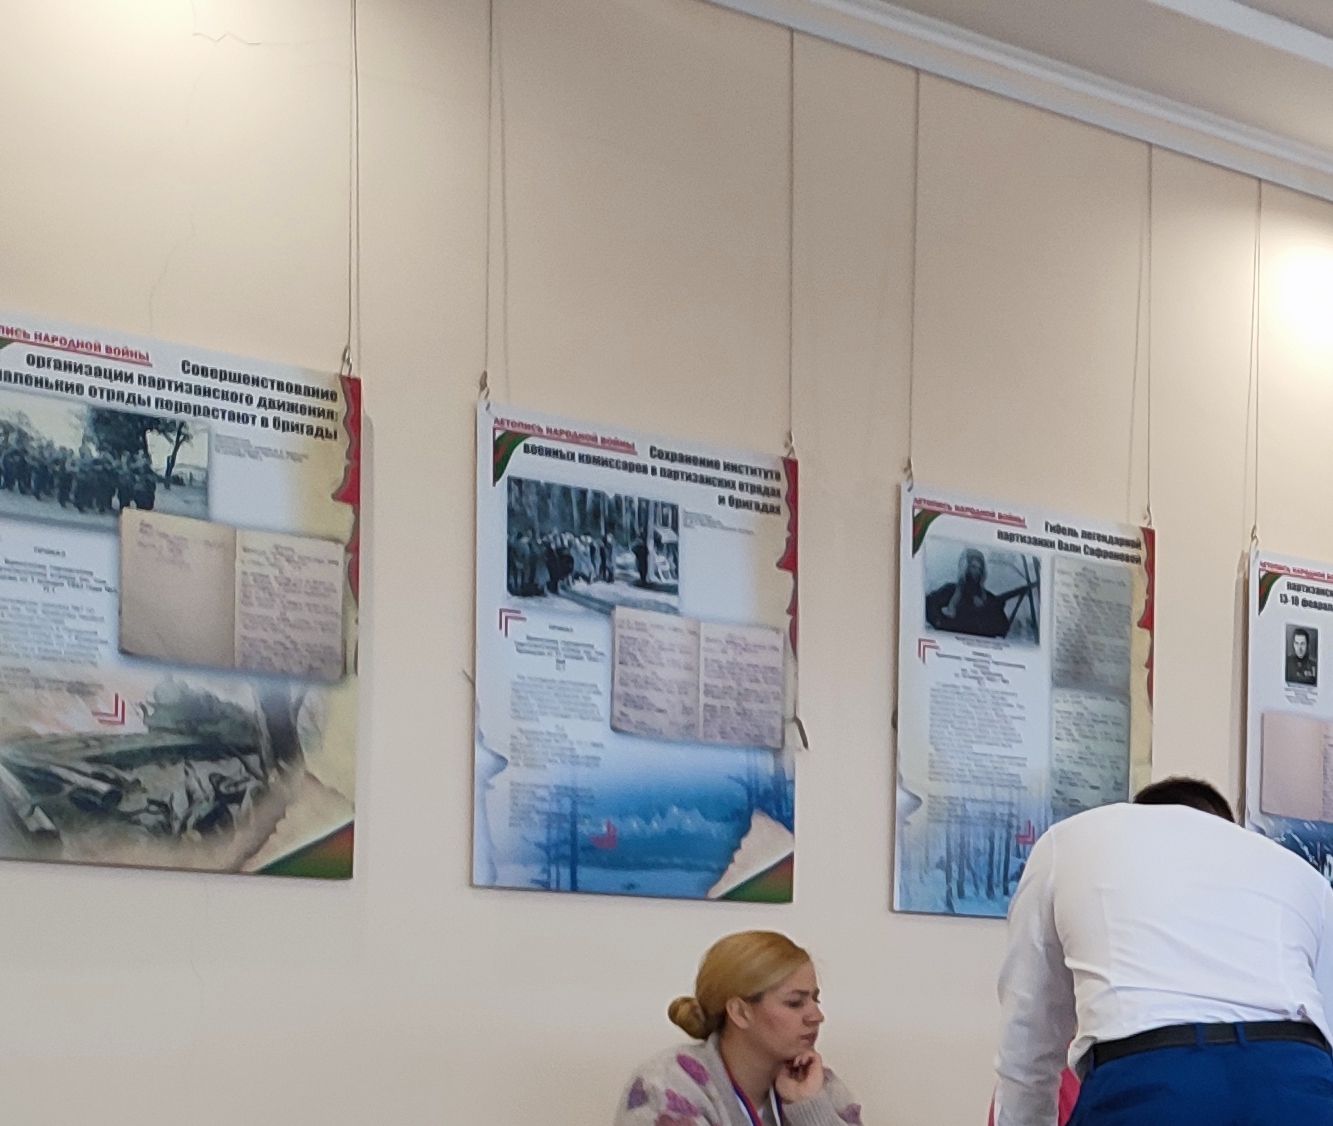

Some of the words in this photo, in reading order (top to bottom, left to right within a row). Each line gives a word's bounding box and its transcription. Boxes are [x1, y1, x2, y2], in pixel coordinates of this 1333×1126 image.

[34, 331, 101, 352] НАРОДНОЙ
[105, 345, 150, 361] ВОЙНЫ
[26, 353, 134, 385] организации
[137, 373, 254, 406] партизанского
[181, 359, 338, 403] Совершенствование
[0, 368, 84, 396] аленькие
[88, 385, 151, 408] отряды
[154, 396, 257, 426] перерастают
[260, 416, 269, 428] в
[272, 416, 338, 441] бригады
[523, 443, 576, 462] военных
[578, 452, 648, 475] комиссаров
[660, 466, 737, 490] партизанских
[739, 480, 781, 498] отрядах
[649, 445, 720, 471] Сохранение
[722, 460, 781, 482] института
[728, 494, 781, 515] бригадах
